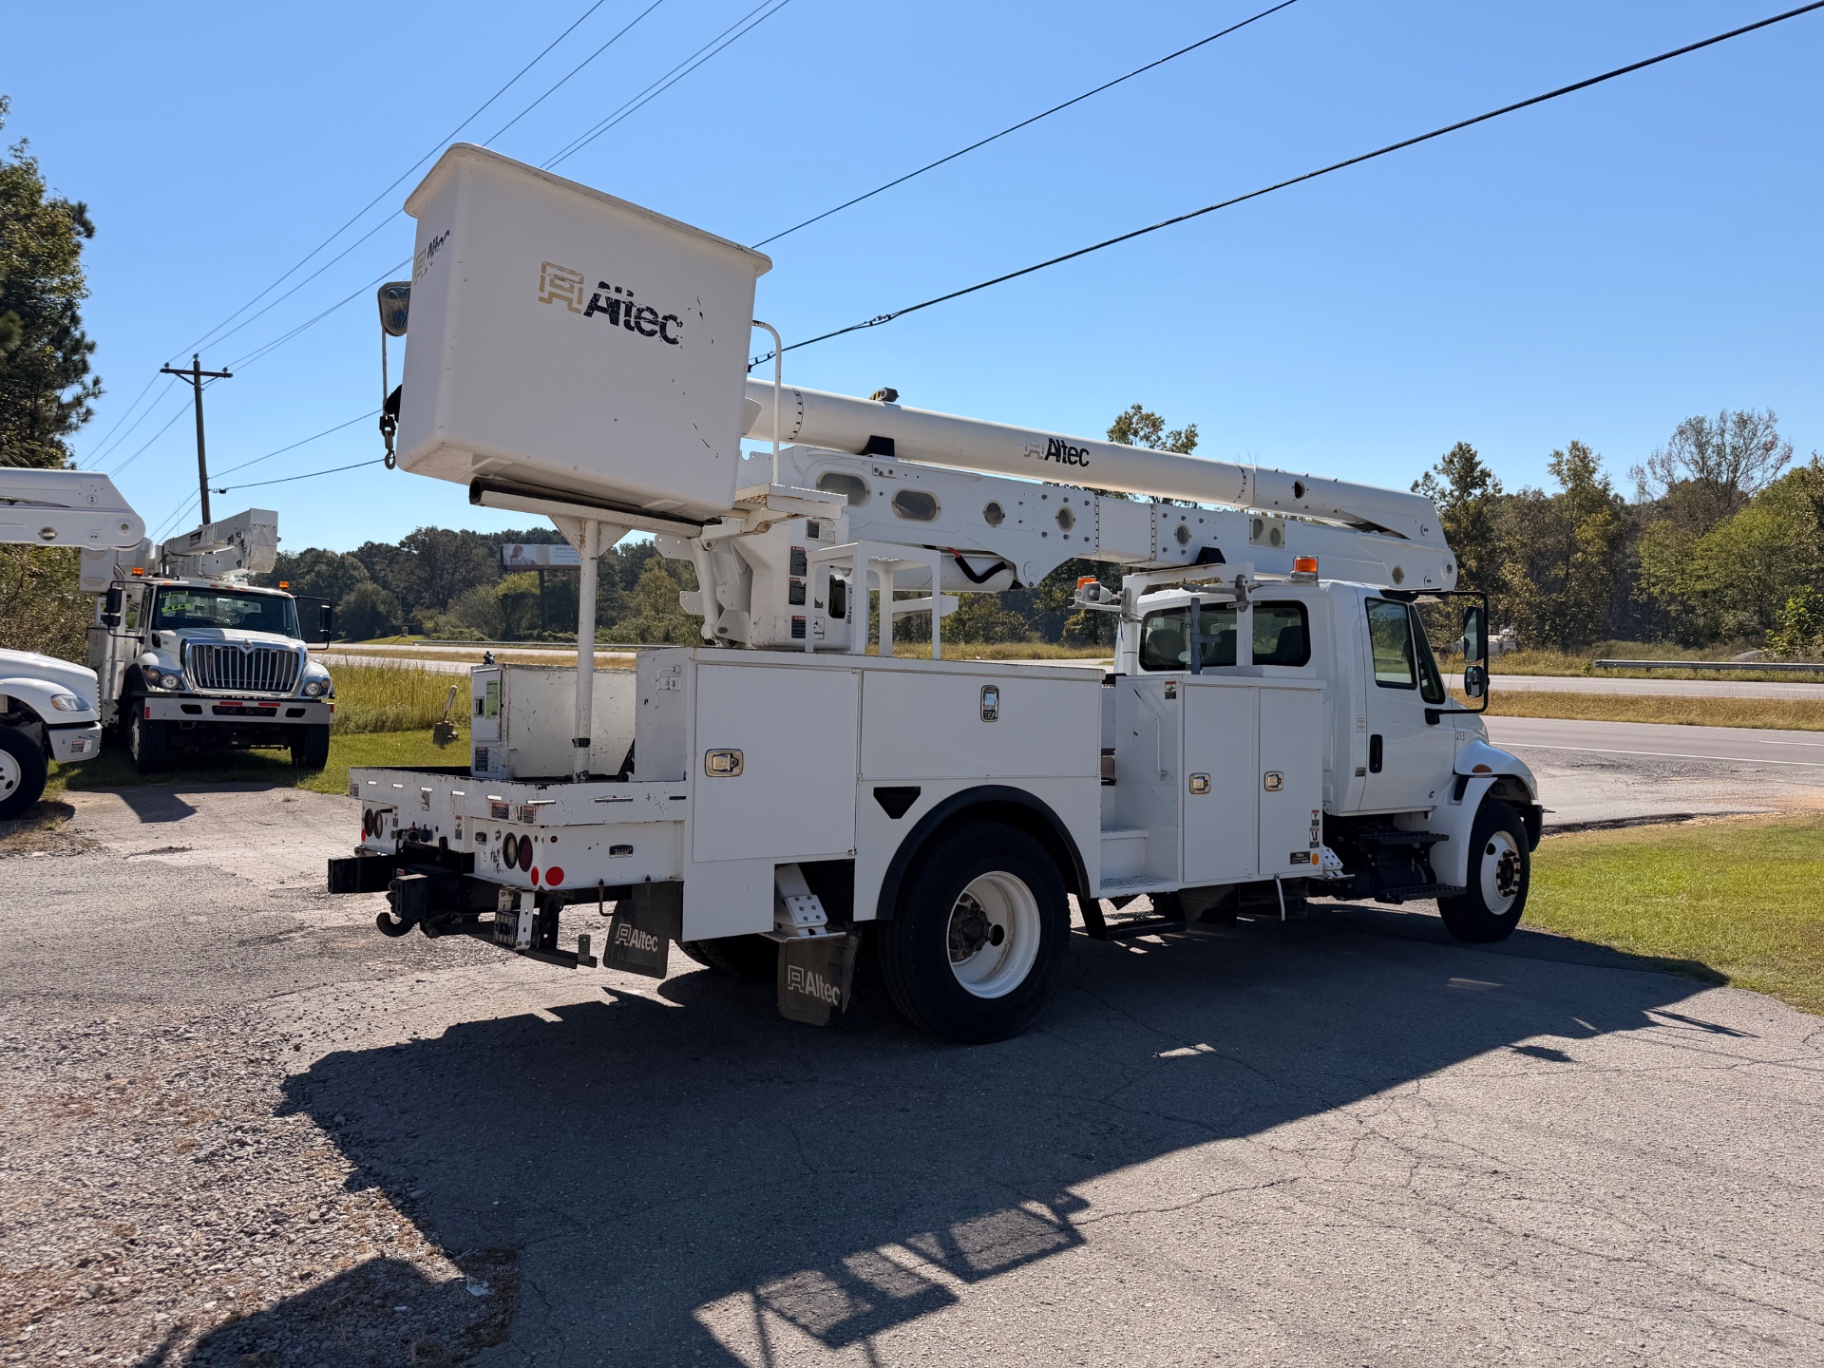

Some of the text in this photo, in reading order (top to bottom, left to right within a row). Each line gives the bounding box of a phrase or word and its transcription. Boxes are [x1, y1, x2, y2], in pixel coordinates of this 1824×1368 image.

[583, 281, 683, 345] Altec
[1044, 438, 1090, 467] Altec
[1456, 731, 1465, 741] 213
[629, 929, 658, 952] Altec
[805, 971, 840, 1006] Altec
